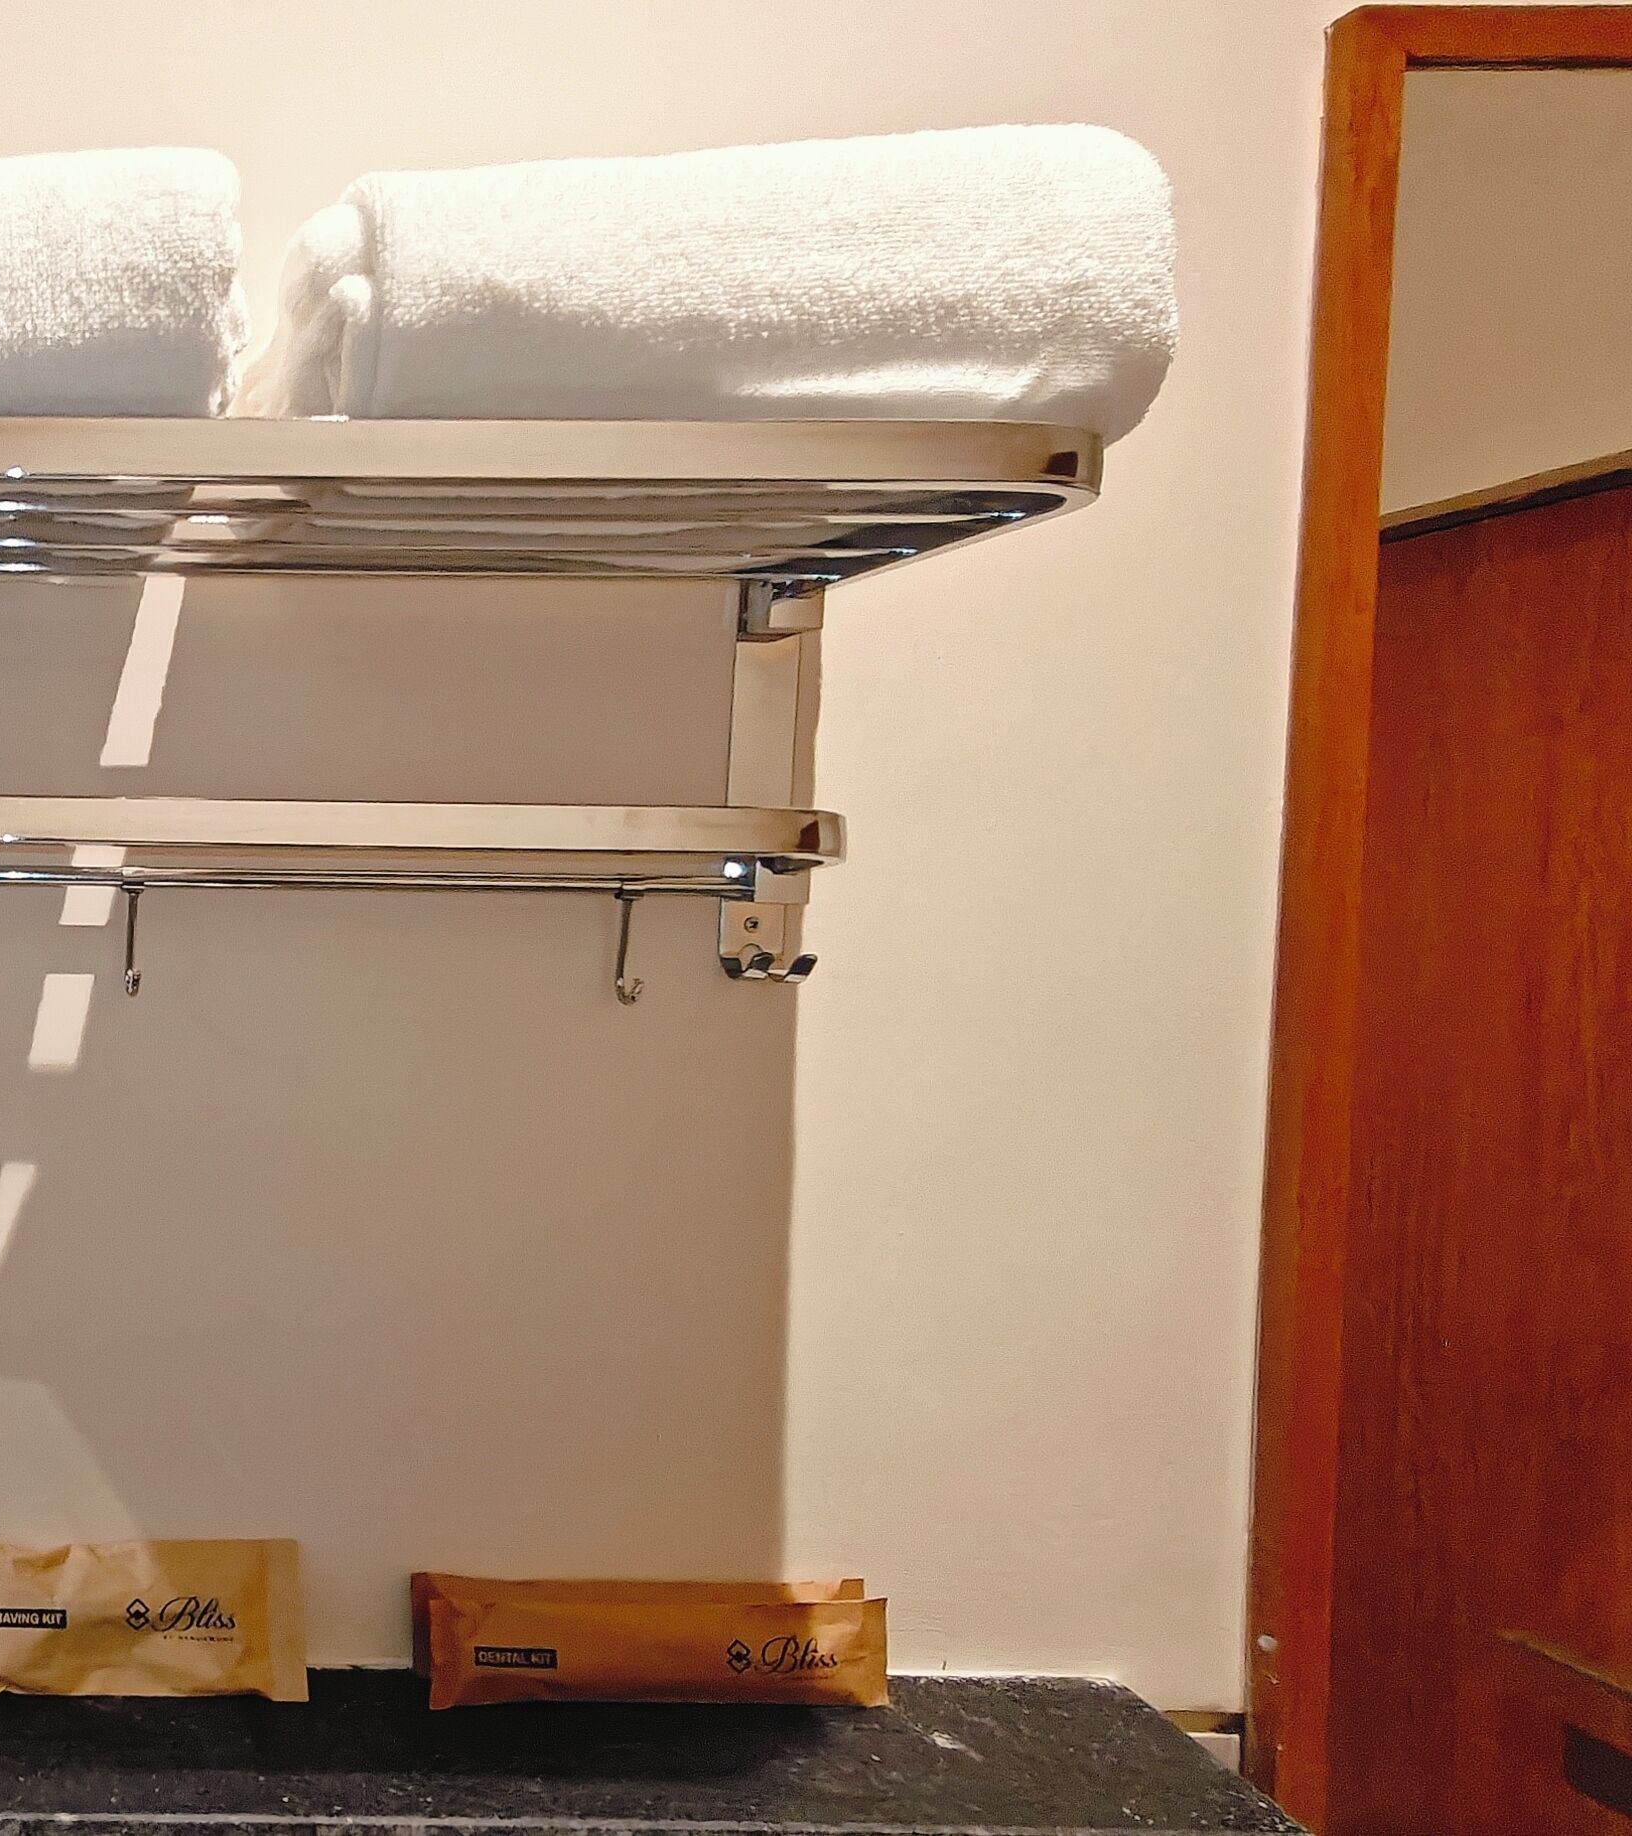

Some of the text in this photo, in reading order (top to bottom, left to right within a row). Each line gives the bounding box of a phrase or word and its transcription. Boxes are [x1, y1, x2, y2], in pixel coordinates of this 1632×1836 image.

[42, 1613, 63, 1625] KIT
[151, 1596, 236, 1632] Bliss
[478, 1651, 530, 1665] DENTAL
[754, 1635, 838, 1674] Bliss
